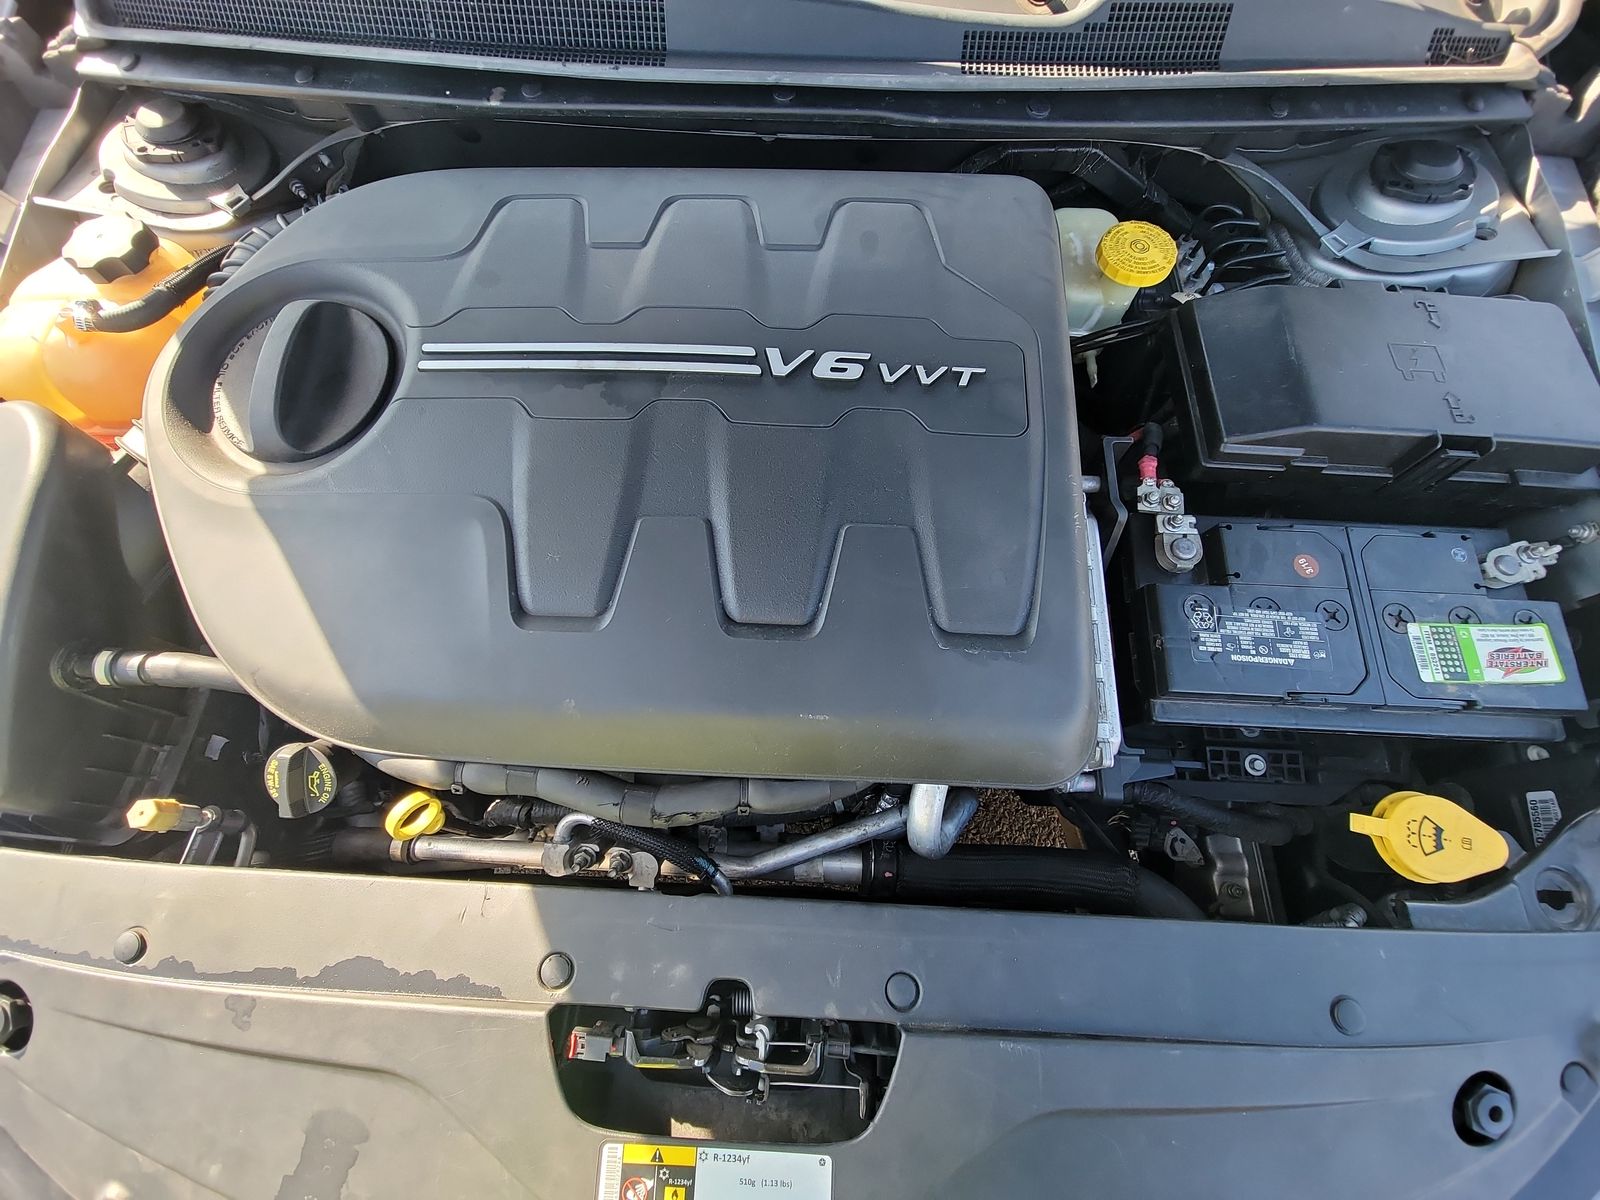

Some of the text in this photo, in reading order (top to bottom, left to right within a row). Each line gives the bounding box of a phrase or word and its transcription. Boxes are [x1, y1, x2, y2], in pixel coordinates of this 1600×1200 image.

[765, 347, 988, 388] V6 VVT
[212, 381, 223, 414] FILTER
[215, 416, 246, 450] SERVICE
[1298, 558, 1314, 575] 3/19
[1230, 653, 1289, 665] DANGER/POISON
[1489, 651, 1543, 660] BATTERIES
[1486, 659, 1548, 669] INTERSTATE
[267, 759, 279, 775] SAE
[317, 763, 333, 804] ENGINE OIL
[713, 1152, 750, 1165] R-1234yf
[668, 1178, 693, 1187] R-1234yf
[739, 1178, 793, 1189] 510g (1.13 lbs)
